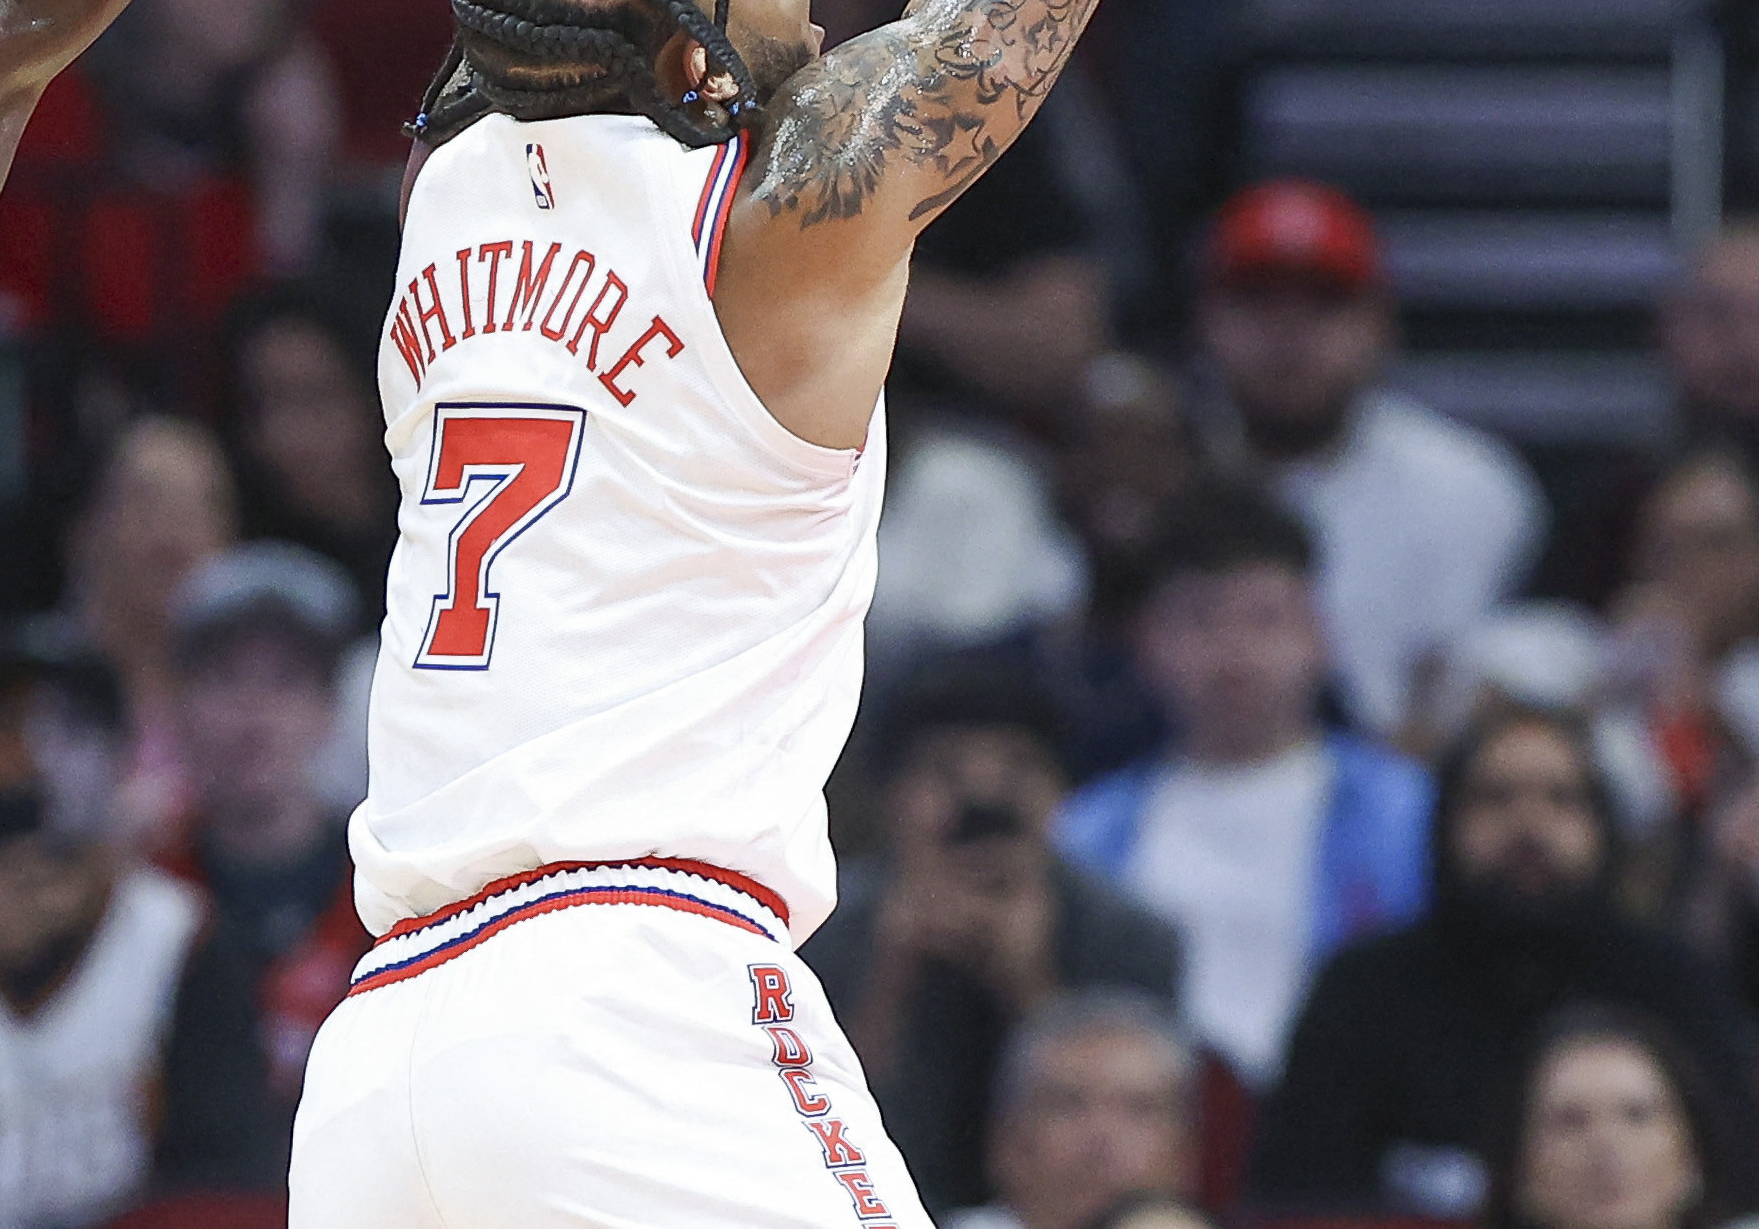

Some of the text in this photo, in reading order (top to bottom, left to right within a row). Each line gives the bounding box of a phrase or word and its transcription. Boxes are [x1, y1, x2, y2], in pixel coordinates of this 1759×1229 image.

[390, 239, 686, 408] WHITMORE
[412, 401, 588, 671] 7
[747, 963, 901, 1229] ROCKE
